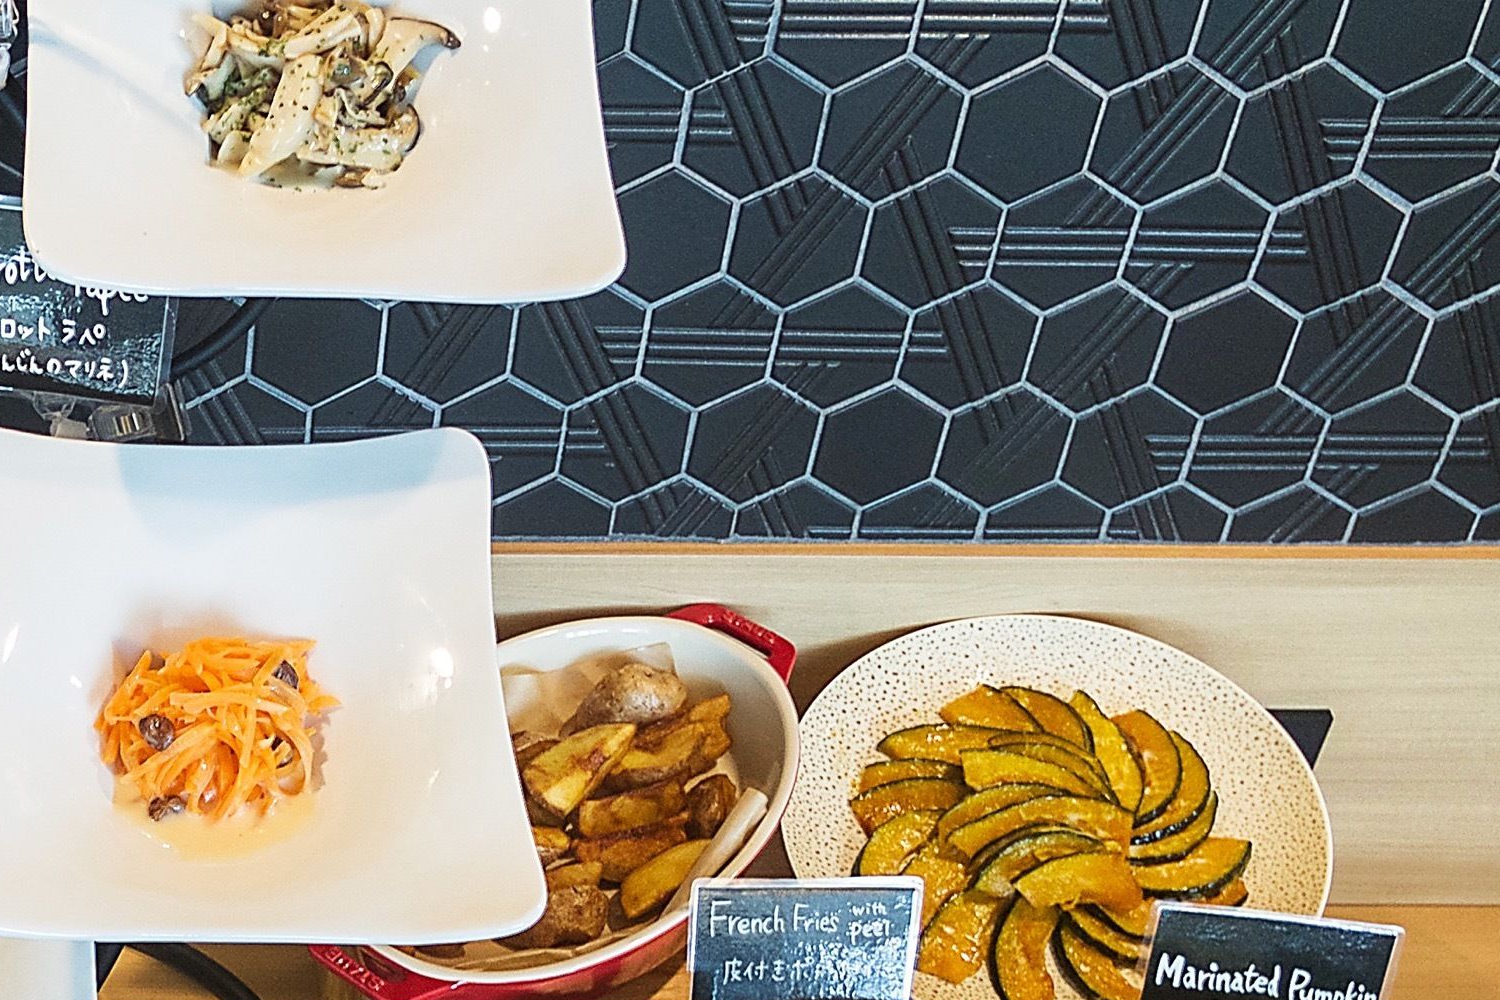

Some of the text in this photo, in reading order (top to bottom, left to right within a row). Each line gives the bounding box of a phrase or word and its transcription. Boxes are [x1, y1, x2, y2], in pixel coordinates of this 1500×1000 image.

[709, 900, 888, 938] French Fries with
[850, 919, 891, 945] peel
[1155, 952, 1282, 999] Marinated
